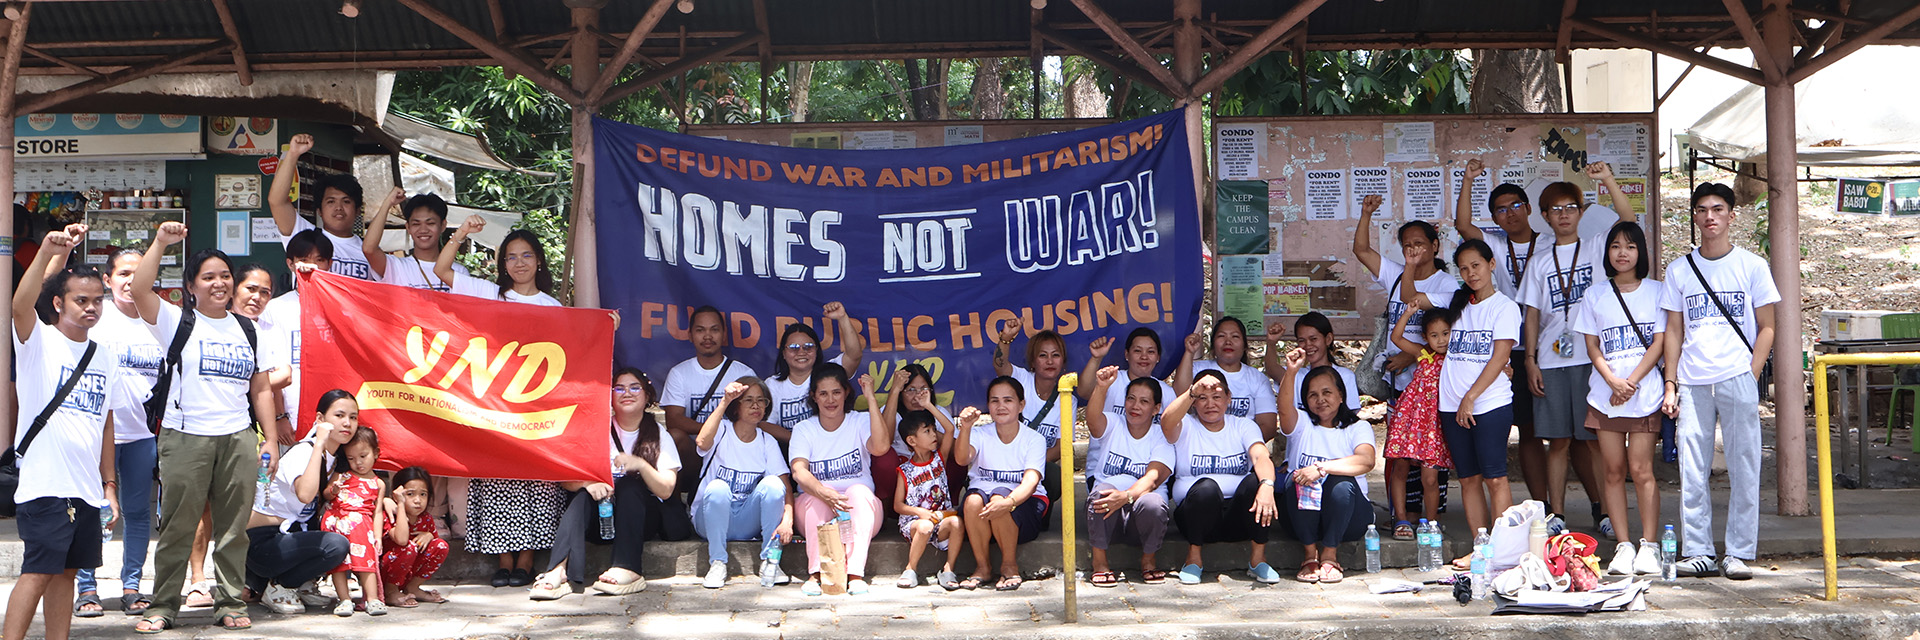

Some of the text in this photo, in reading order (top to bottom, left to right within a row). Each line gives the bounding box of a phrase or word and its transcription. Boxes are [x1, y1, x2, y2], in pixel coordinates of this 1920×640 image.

[1221, 129, 1254, 137] CONDO
[16, 139, 79, 154] STORE
[636, 123, 1164, 188] DEFUND WAR AND MILITARISM!
[1353, 169, 1387, 177] CONDO
[1407, 170, 1441, 178] CONDO
[1619, 184, 1643, 193] ARKET
[1844, 183, 1865, 196] ISAW
[1232, 194, 1254, 202] KEEP
[1843, 196, 1869, 209] BABOY
[1234, 204, 1251, 213] THE
[637, 170, 1161, 283] HOMES NOT WAR!
[1226, 215, 1259, 223] CAMPUS
[1229, 226, 1256, 234] CLEAN
[329, 260, 367, 279] OMES
[1277, 285, 1306, 294] MARKET
[1686, 294, 1705, 309] OUR
[640, 301, 760, 349] FUD
[948, 281, 1173, 351] HOUSING!
[1463, 331, 1492, 343] HOMES
[1602, 327, 1622, 343] OUR
[201, 341, 253, 361] HOMES
[129, 355, 162, 368] POWE
[201, 359, 253, 379] NOT WAR
[403, 325, 567, 404] YND
[61, 368, 106, 395] HMES
[366, 389, 394, 399] YOUTH
[398, 391, 414, 402] FOR
[419, 396, 478, 417] NATIONALISM
[500, 419, 556, 432] DEMOCRACY
[781, 399, 813, 418] HOM
[1231, 398, 1249, 410] MES
[1037, 424, 1059, 438] MES
[828, 451, 862, 472] HOMES
[1124, 459, 1148, 476] HOM
[1191, 453, 1248, 468] OUR HOMES
[717, 465, 761, 486] OUR HOM
